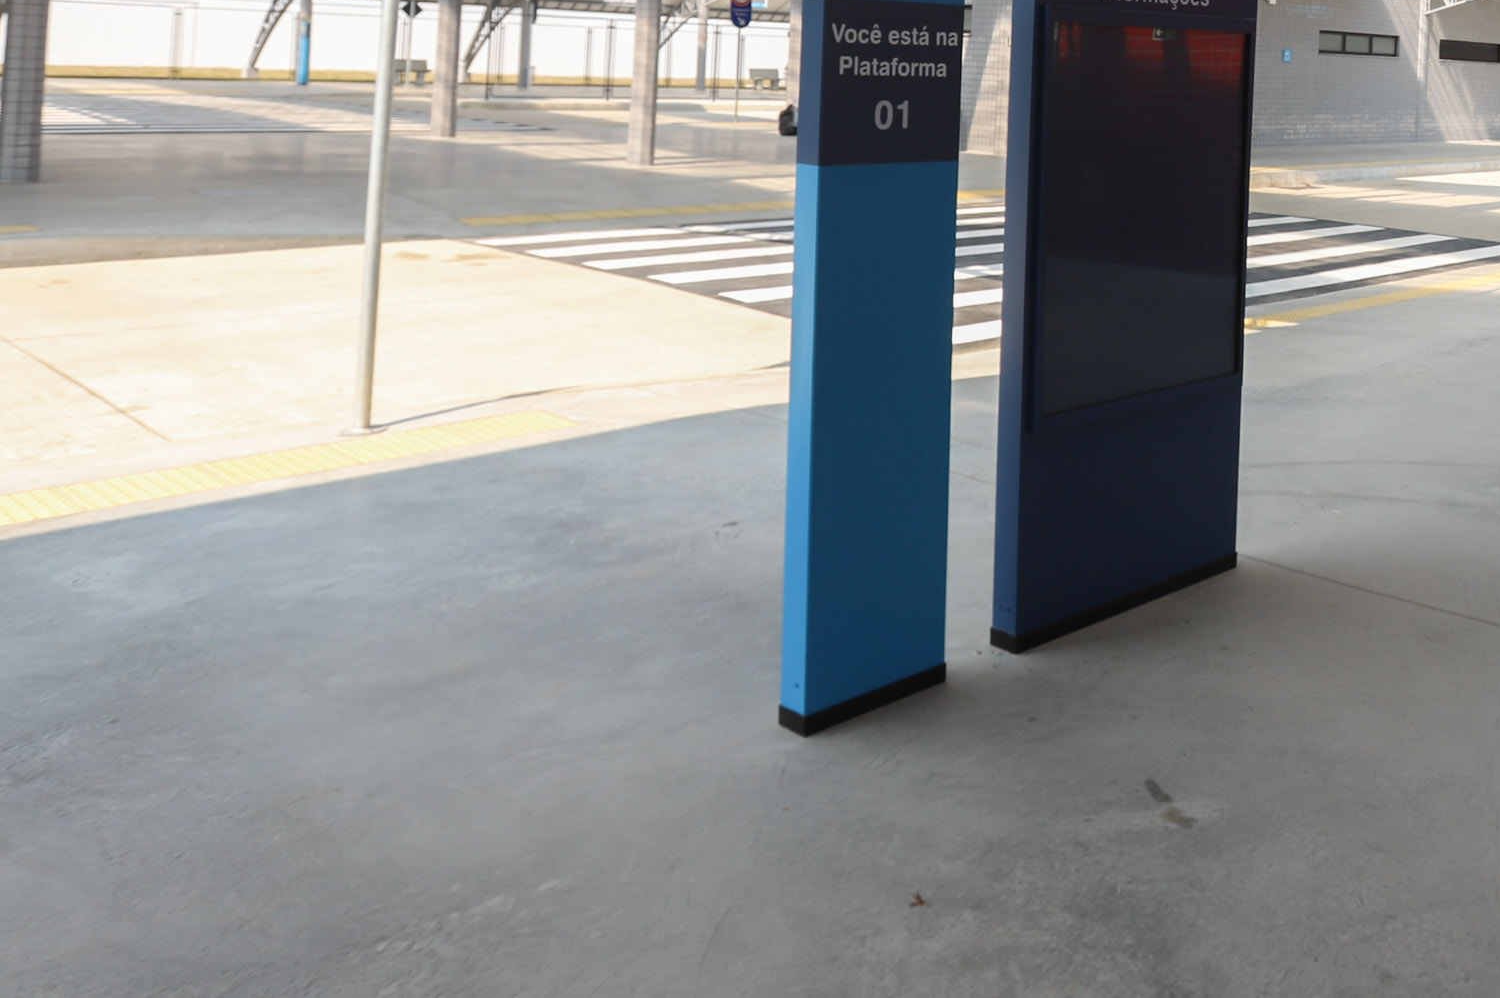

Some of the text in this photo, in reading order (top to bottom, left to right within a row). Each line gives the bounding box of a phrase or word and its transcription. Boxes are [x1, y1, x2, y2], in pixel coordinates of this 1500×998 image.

[831, 23, 959, 46] Você está na
[839, 55, 947, 78] Plataforma
[874, 99, 909, 130] 01
